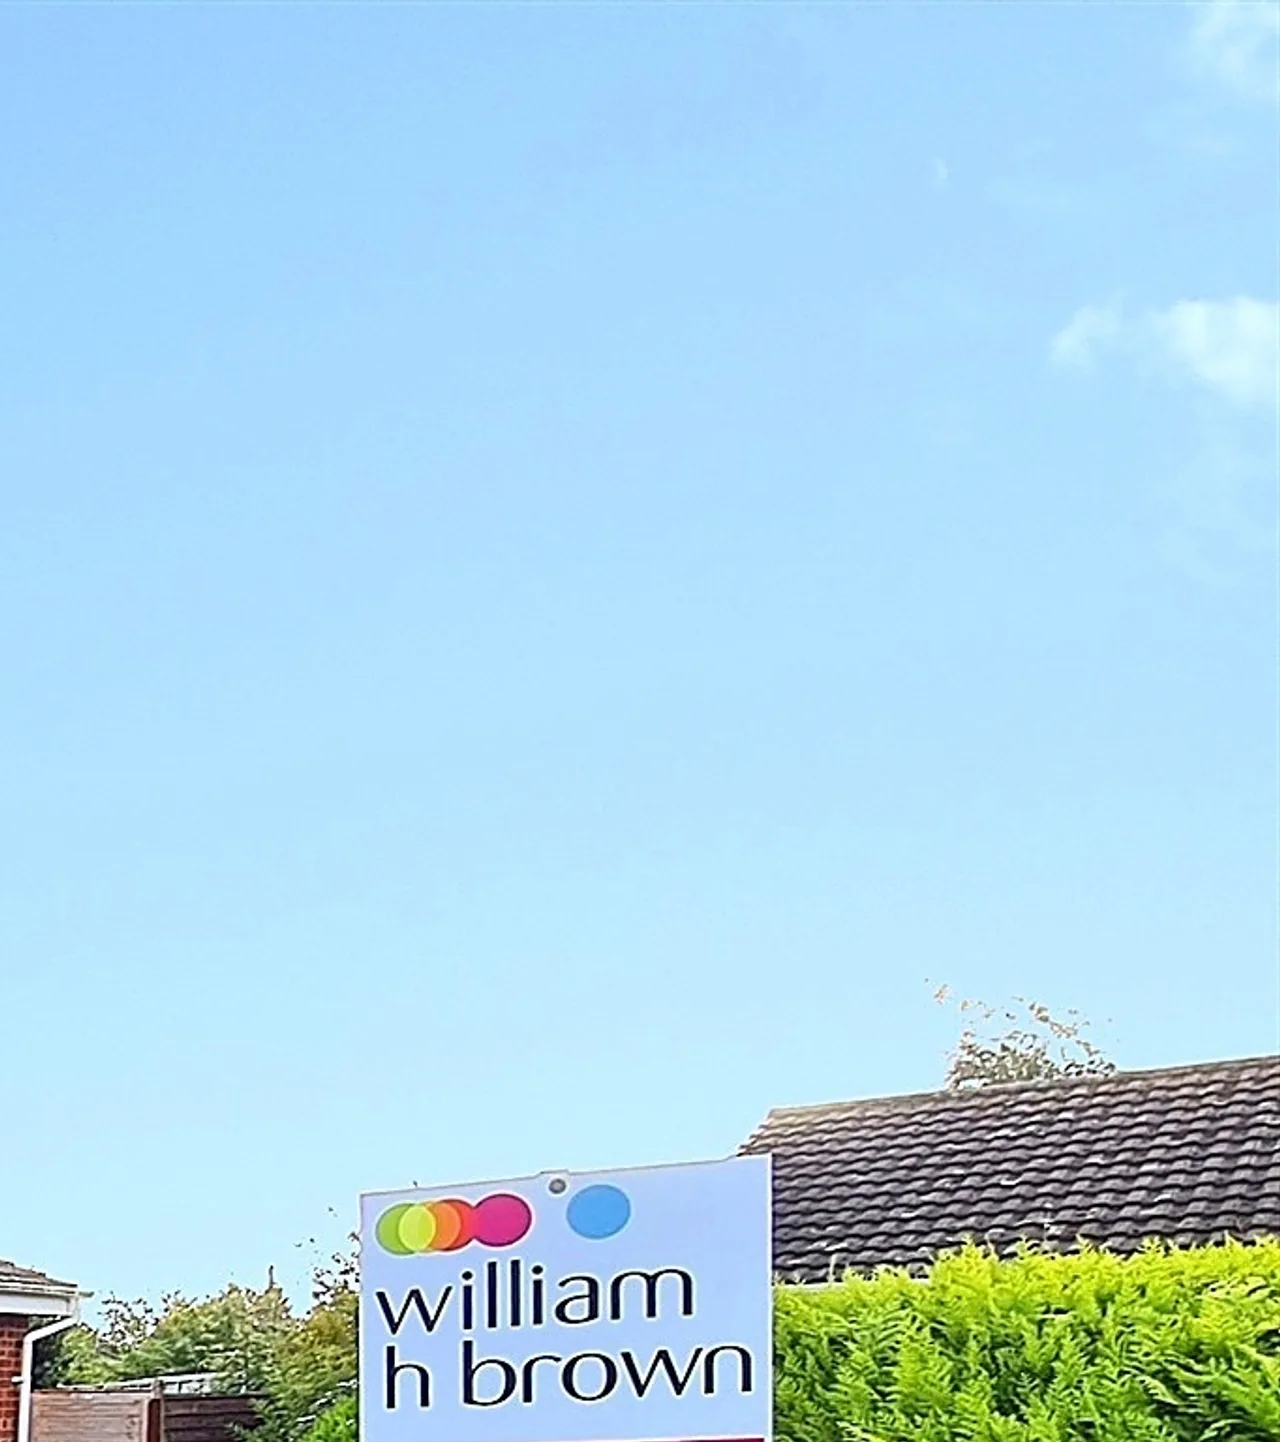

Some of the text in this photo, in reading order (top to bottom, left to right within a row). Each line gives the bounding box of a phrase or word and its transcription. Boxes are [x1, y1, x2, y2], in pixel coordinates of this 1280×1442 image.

[377, 1260, 692, 1334] william
[386, 1340, 752, 1408] h brown
